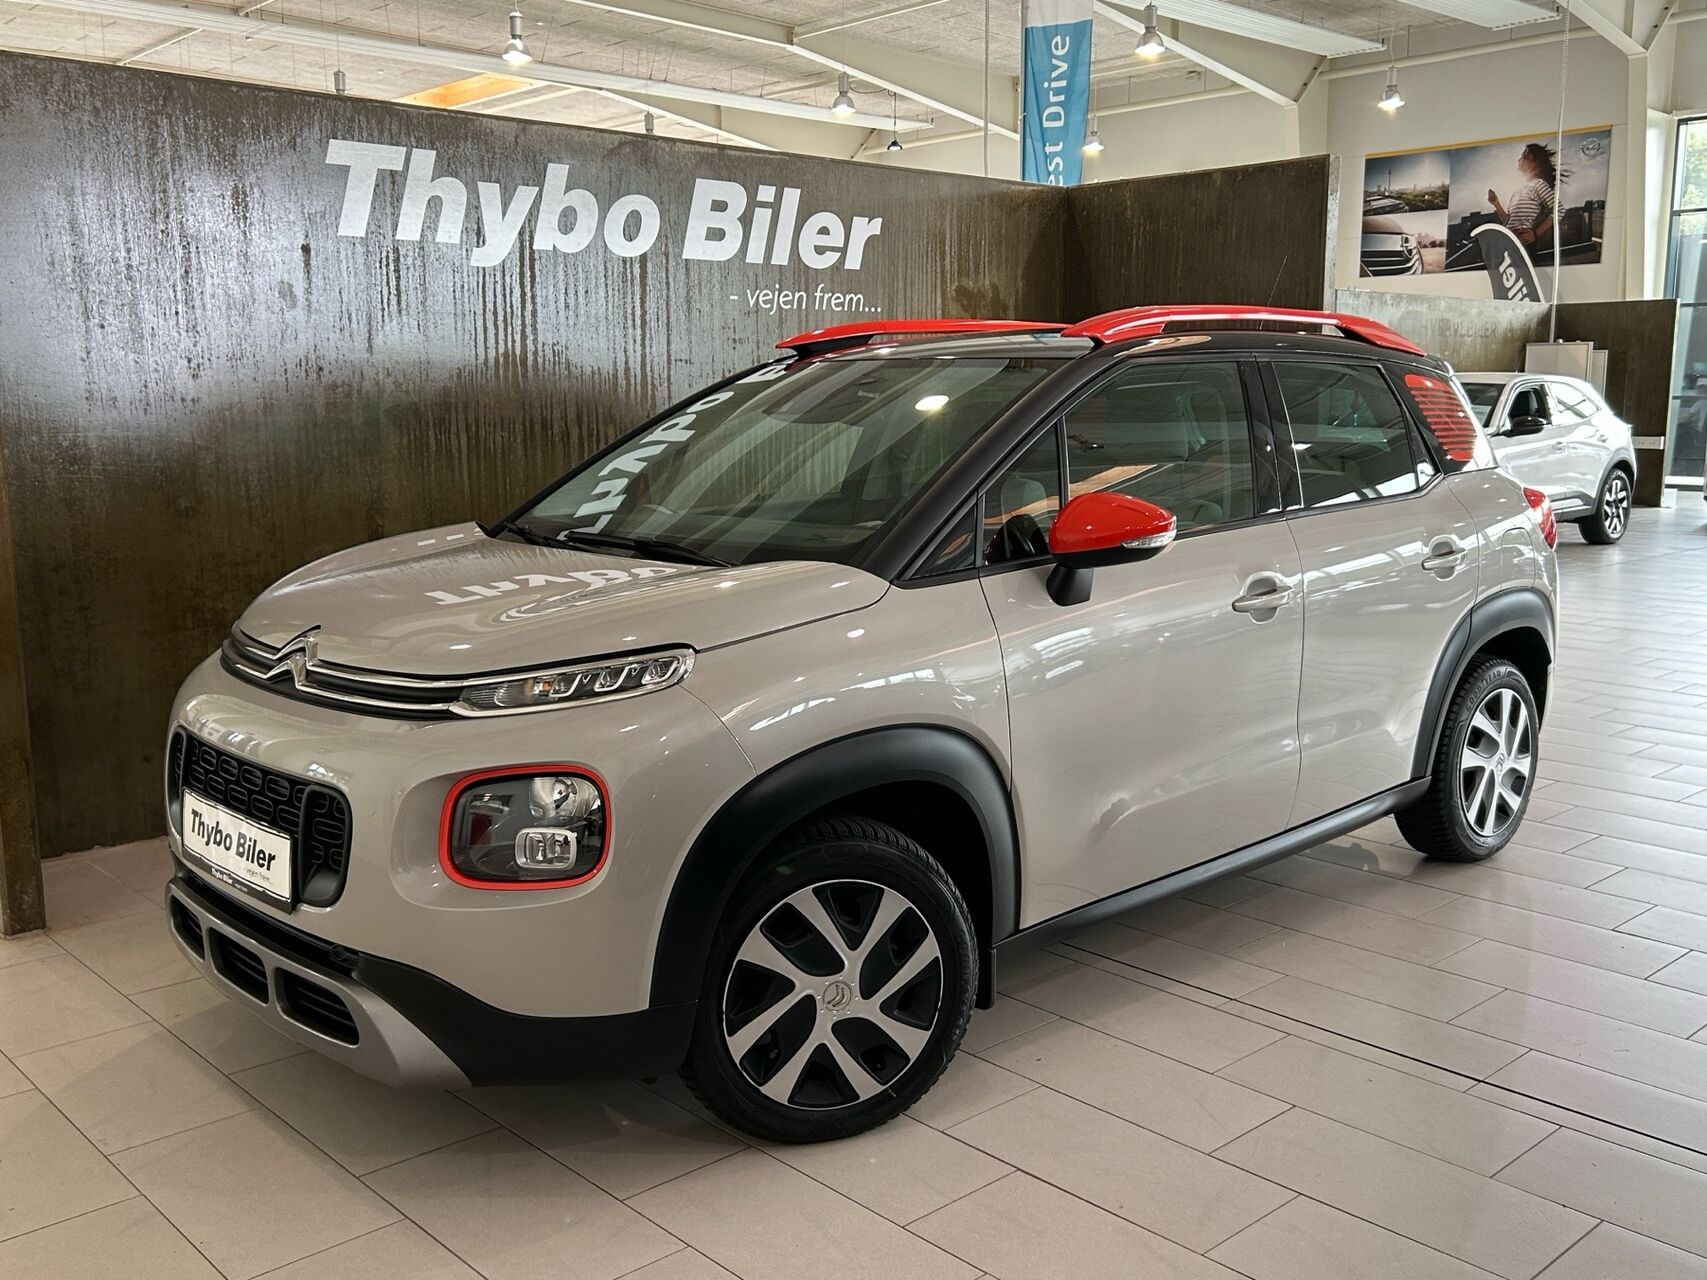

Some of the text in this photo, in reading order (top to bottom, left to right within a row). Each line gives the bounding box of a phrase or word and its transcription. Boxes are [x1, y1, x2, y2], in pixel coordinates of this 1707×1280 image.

[1043, 35, 1069, 186] est Drive
[325, 139, 883, 270] Thybo Biler
[746, 284, 808, 315] vejen
[813, 284, 883, 313] frem...
[191, 808, 276, 871] Thybo Biler
